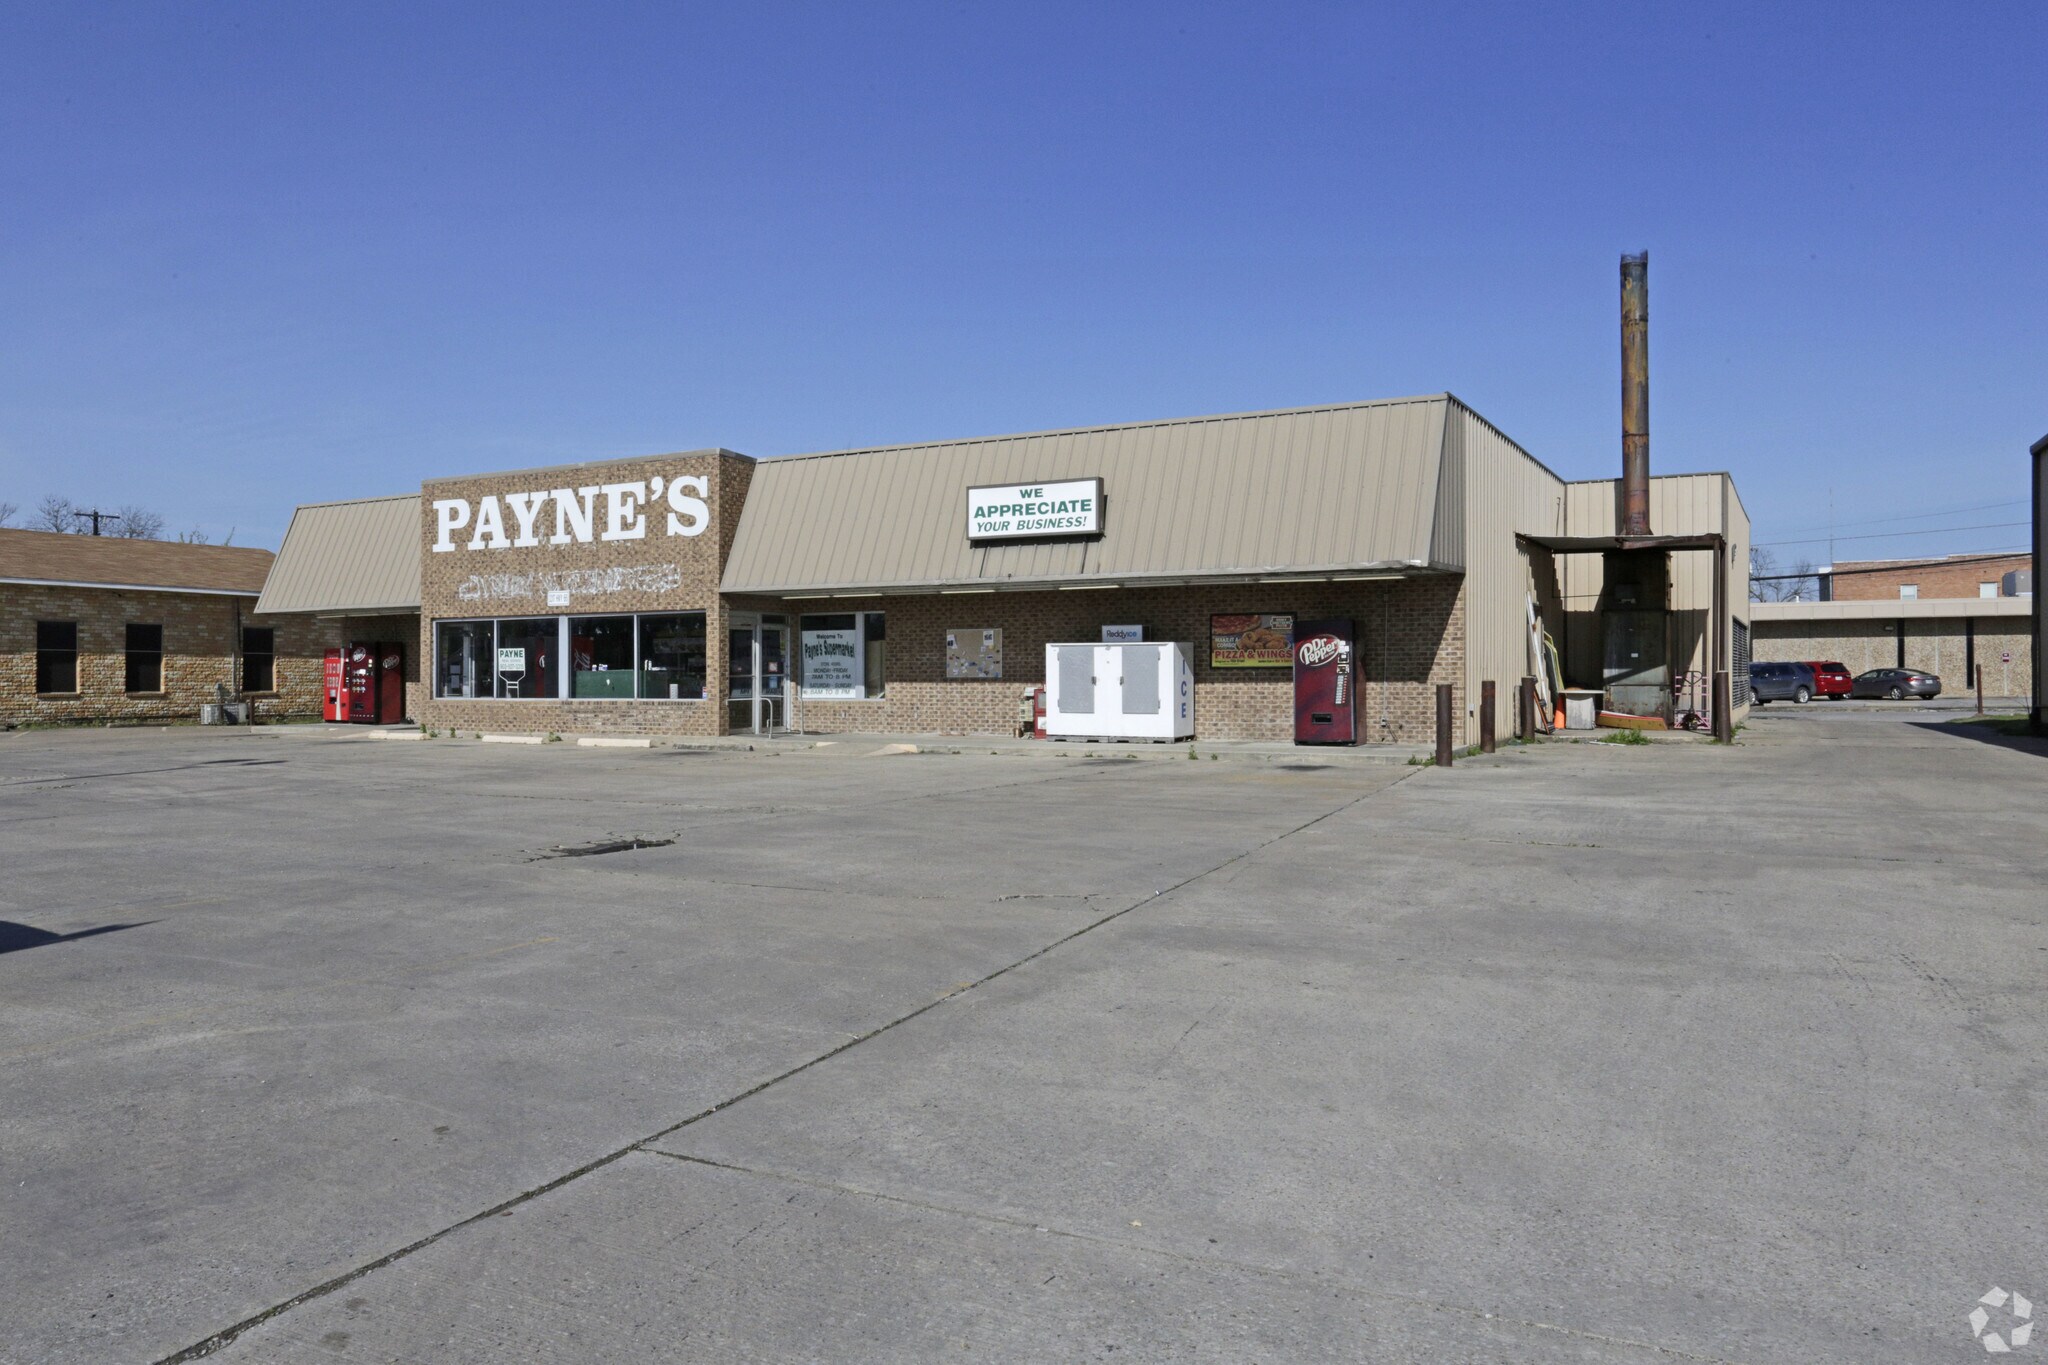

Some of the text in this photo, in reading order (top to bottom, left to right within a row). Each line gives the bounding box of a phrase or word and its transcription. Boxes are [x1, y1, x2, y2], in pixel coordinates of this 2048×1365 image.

[1019, 488, 1044, 499] WE
[432, 475, 709, 553] PAYNE'S
[973, 498, 1092, 519] APPRECIATE
[976, 516, 1088, 533] YOUR BUSINESS!
[804, 640, 855, 660] Payne's Supermarket
[1303, 641, 1338, 665] Pepper
[1311, 638, 1327, 652] Dr
[499, 650, 523, 658] PAYNE
[1214, 649, 1293, 659] PIZZA & WINGS
